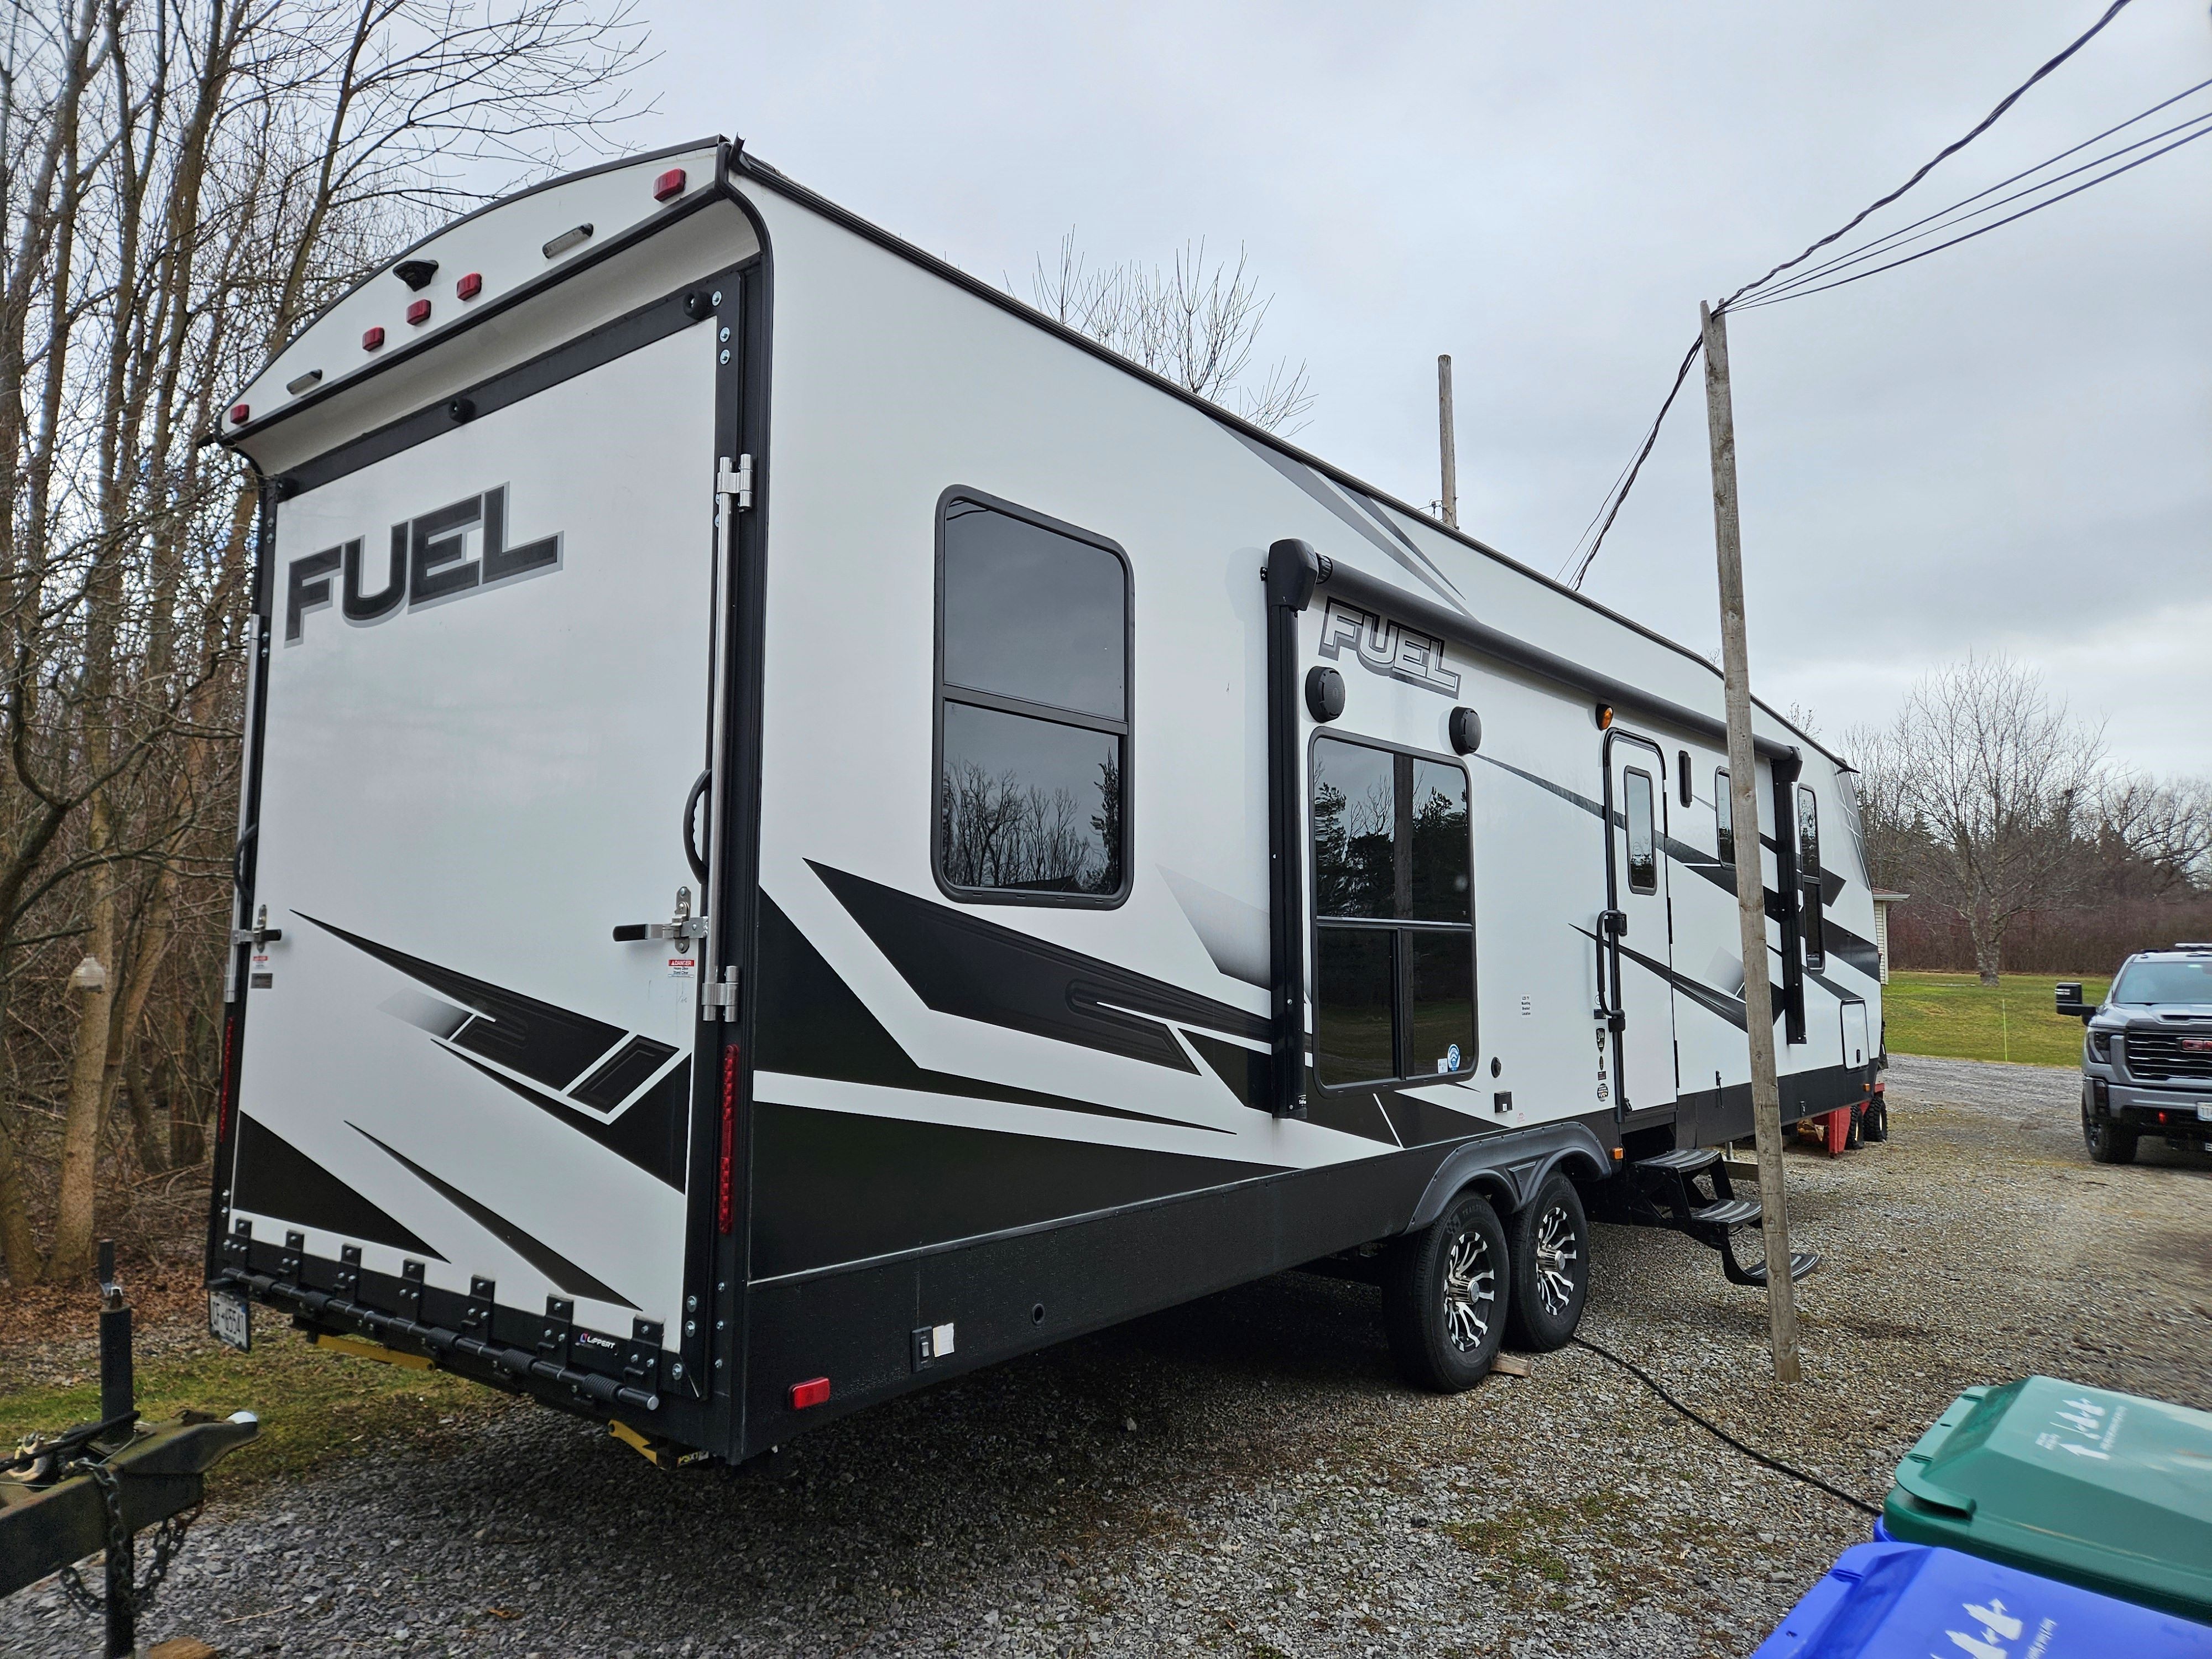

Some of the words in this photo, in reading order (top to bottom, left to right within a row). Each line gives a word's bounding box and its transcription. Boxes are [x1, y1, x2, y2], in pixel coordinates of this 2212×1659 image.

[284, 481, 564, 648] FUEL
[1318, 596, 1462, 700] FUEL
[587, 1335, 615, 1349] LIPPERT
